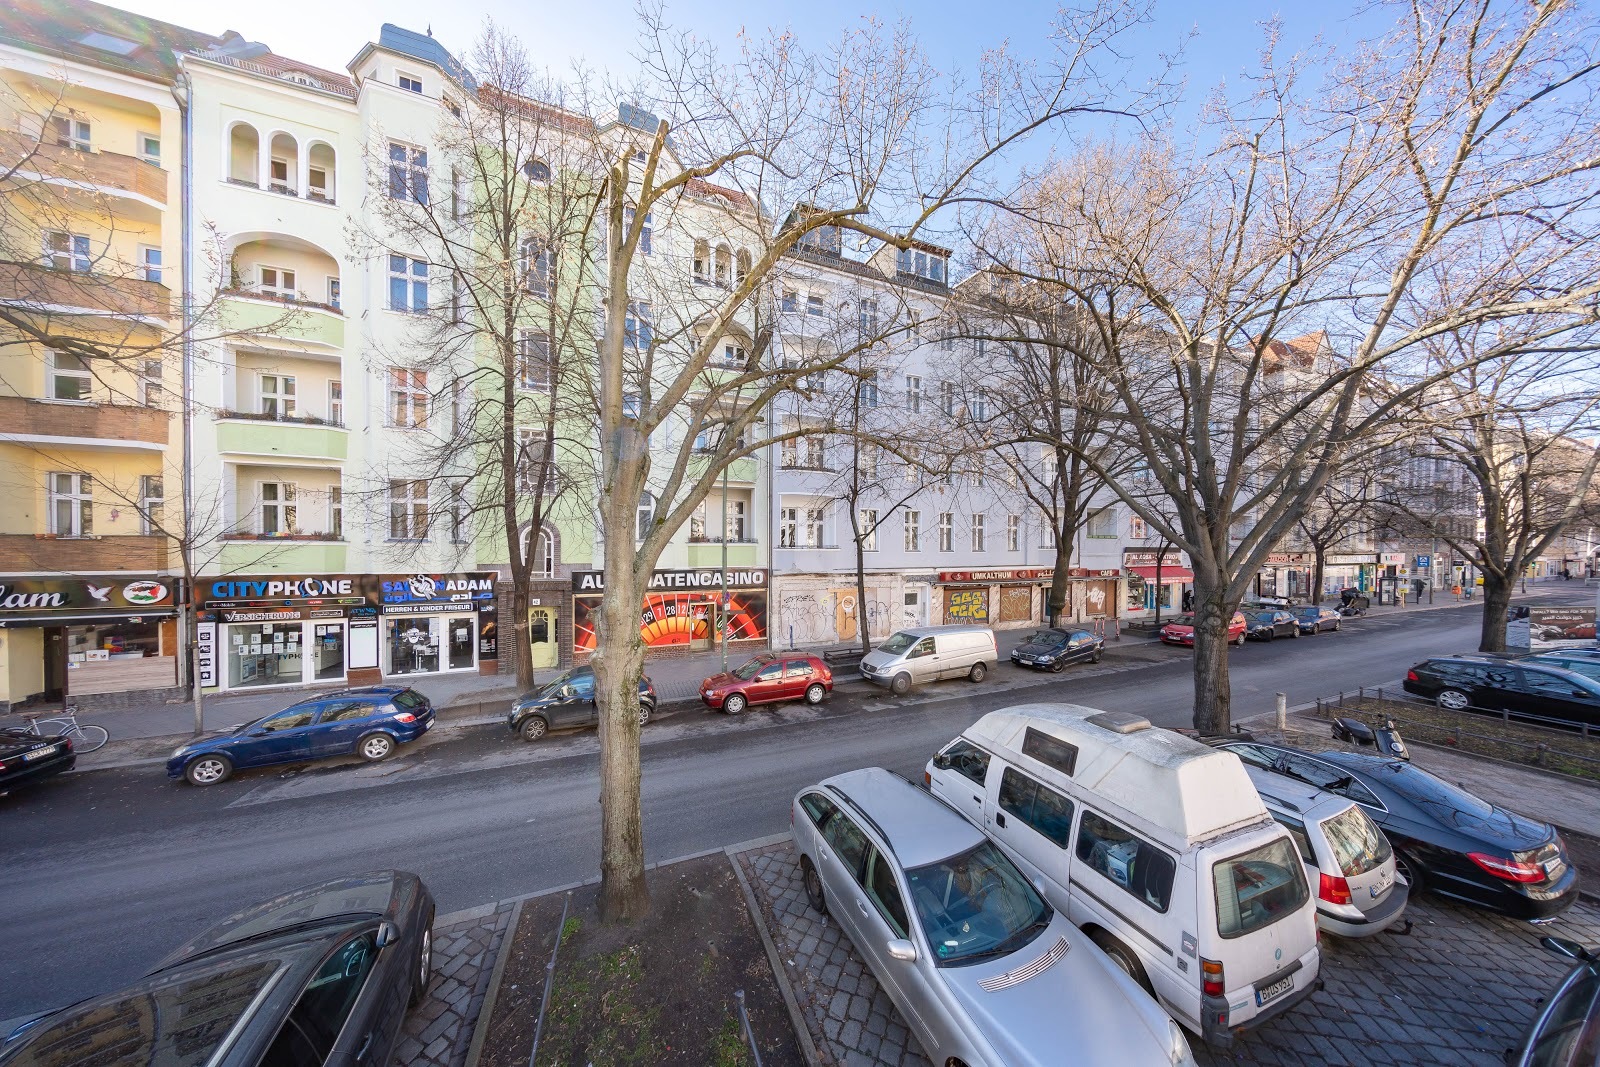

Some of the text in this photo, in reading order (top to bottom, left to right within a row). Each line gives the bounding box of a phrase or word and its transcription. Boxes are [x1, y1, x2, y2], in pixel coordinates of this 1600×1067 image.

[972, 571, 1012, 581] UMKALTHUM
[446, 579, 493, 591] ADAM
[666, 605, 676, 616] 28
[225, 611, 301, 622] VERSICHERUNG
